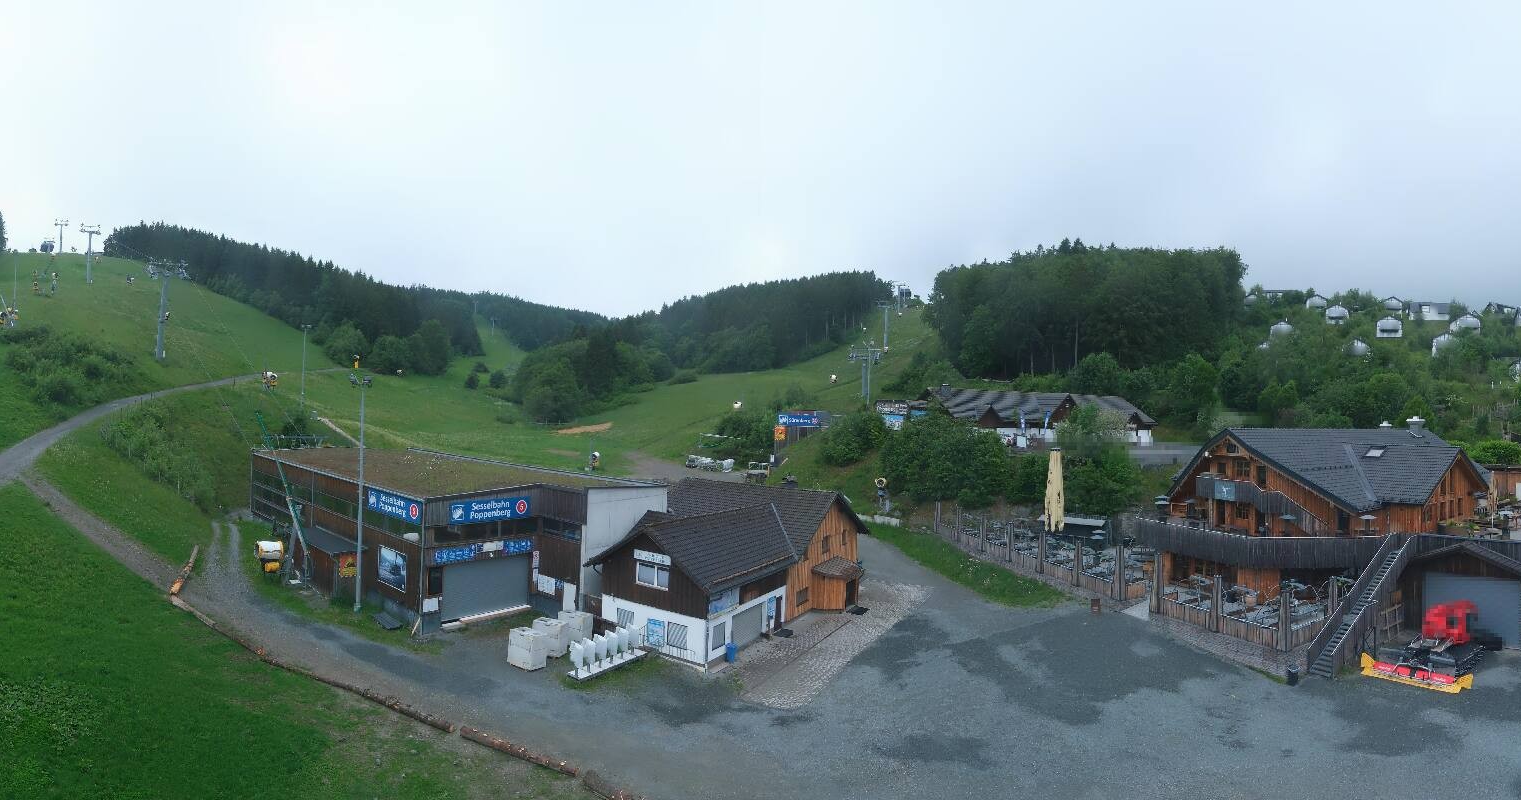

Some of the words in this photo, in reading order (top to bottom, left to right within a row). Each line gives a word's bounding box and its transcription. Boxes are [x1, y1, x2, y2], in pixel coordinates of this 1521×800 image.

[471, 500, 510, 511] Sesselbahn
[519, 503, 524, 511] 5
[470, 509, 511, 520] Poppenberg
